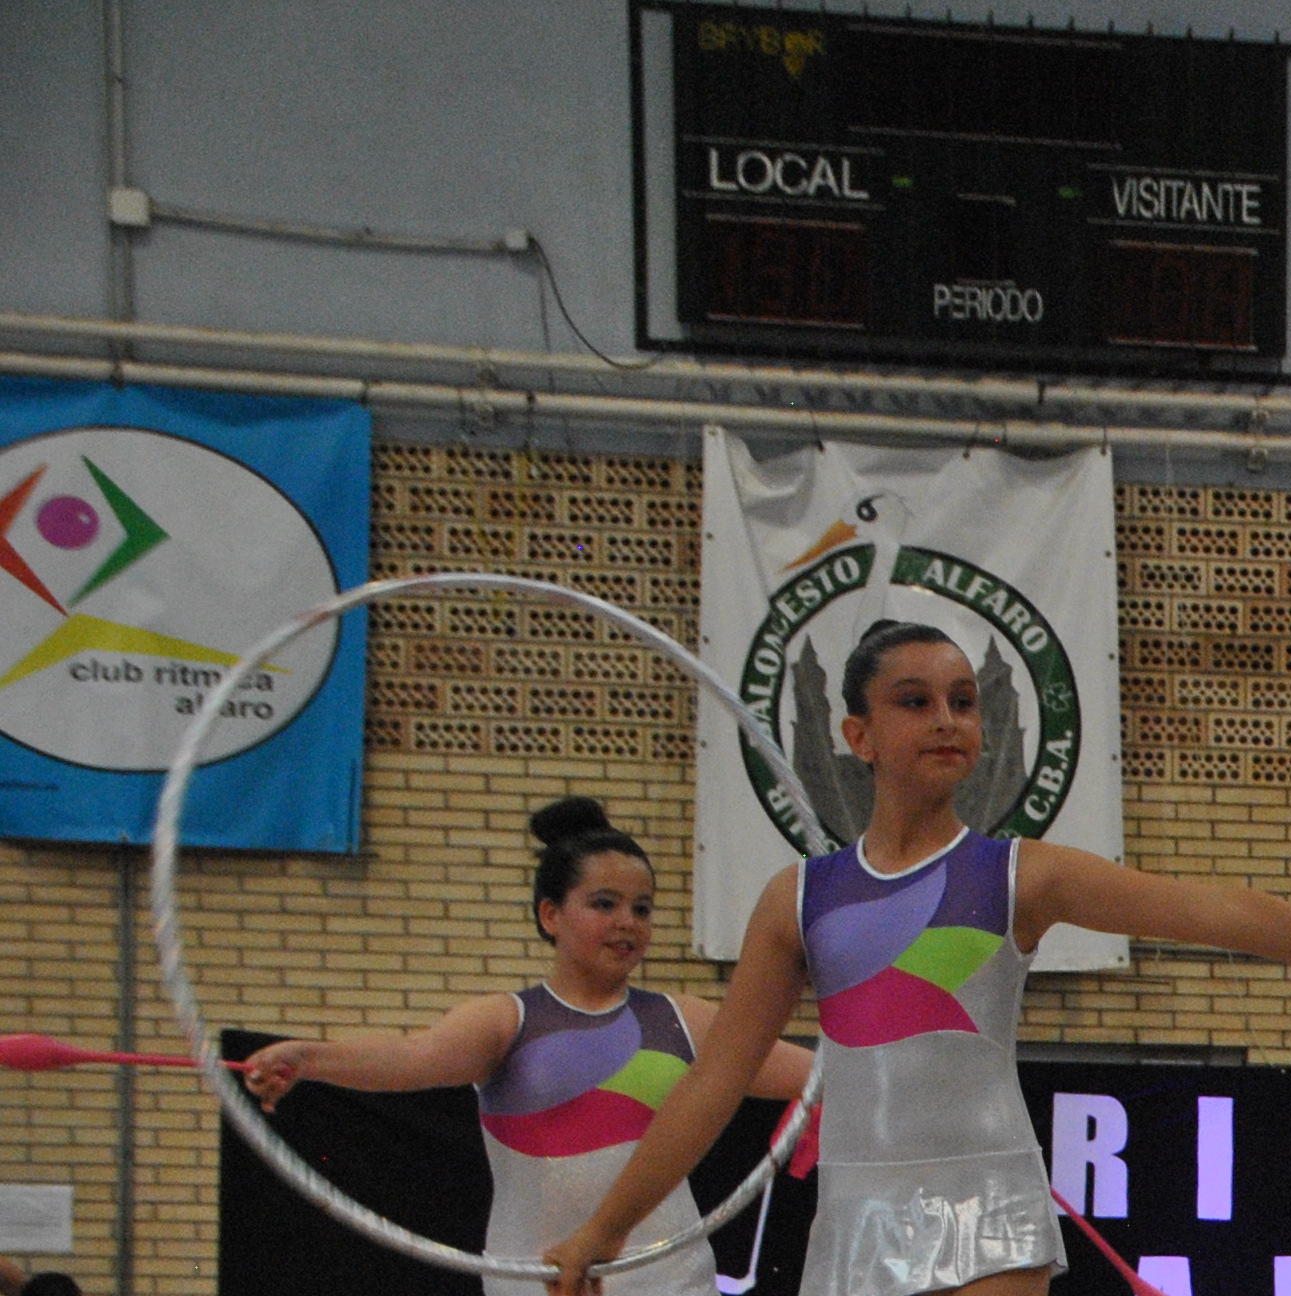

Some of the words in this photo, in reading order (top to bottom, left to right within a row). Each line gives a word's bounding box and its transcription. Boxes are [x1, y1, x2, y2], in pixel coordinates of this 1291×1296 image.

[709, 148, 869, 200] LOCAL
[1112, 176, 1261, 225] VISITANTE
[933, 284, 1044, 323] PERIODO
[923, 559, 1048, 652] ALFARO
[69, 657, 144, 683] club
[154, 661, 274, 692] ritmca
[174, 692, 274, 720] alaro
[1024, 729, 1073, 821] C.B.A.
